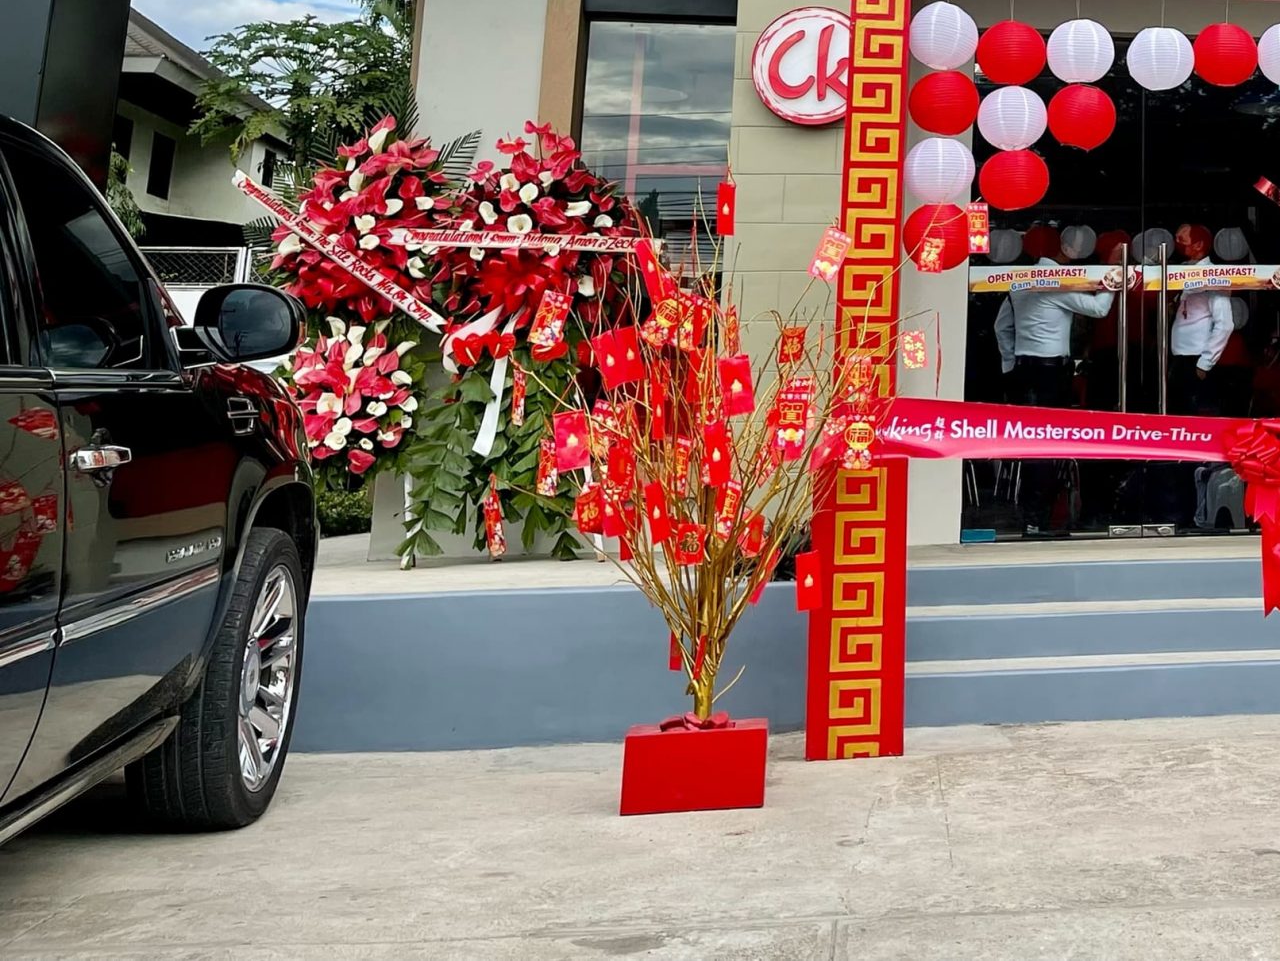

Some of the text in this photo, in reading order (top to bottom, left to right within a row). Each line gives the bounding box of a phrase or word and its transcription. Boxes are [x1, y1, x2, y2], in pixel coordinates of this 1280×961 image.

[987, 268, 1087, 284] OPEN FOR BREAKFAST!
[1168, 271, 1186, 281] PEN
[1202, 267, 1256, 278] BREAKFAST!
[950, 419, 997, 440] Shell
[1004, 420, 1105, 441] Masterson
[1112, 424, 1213, 442] Drive-Thru
